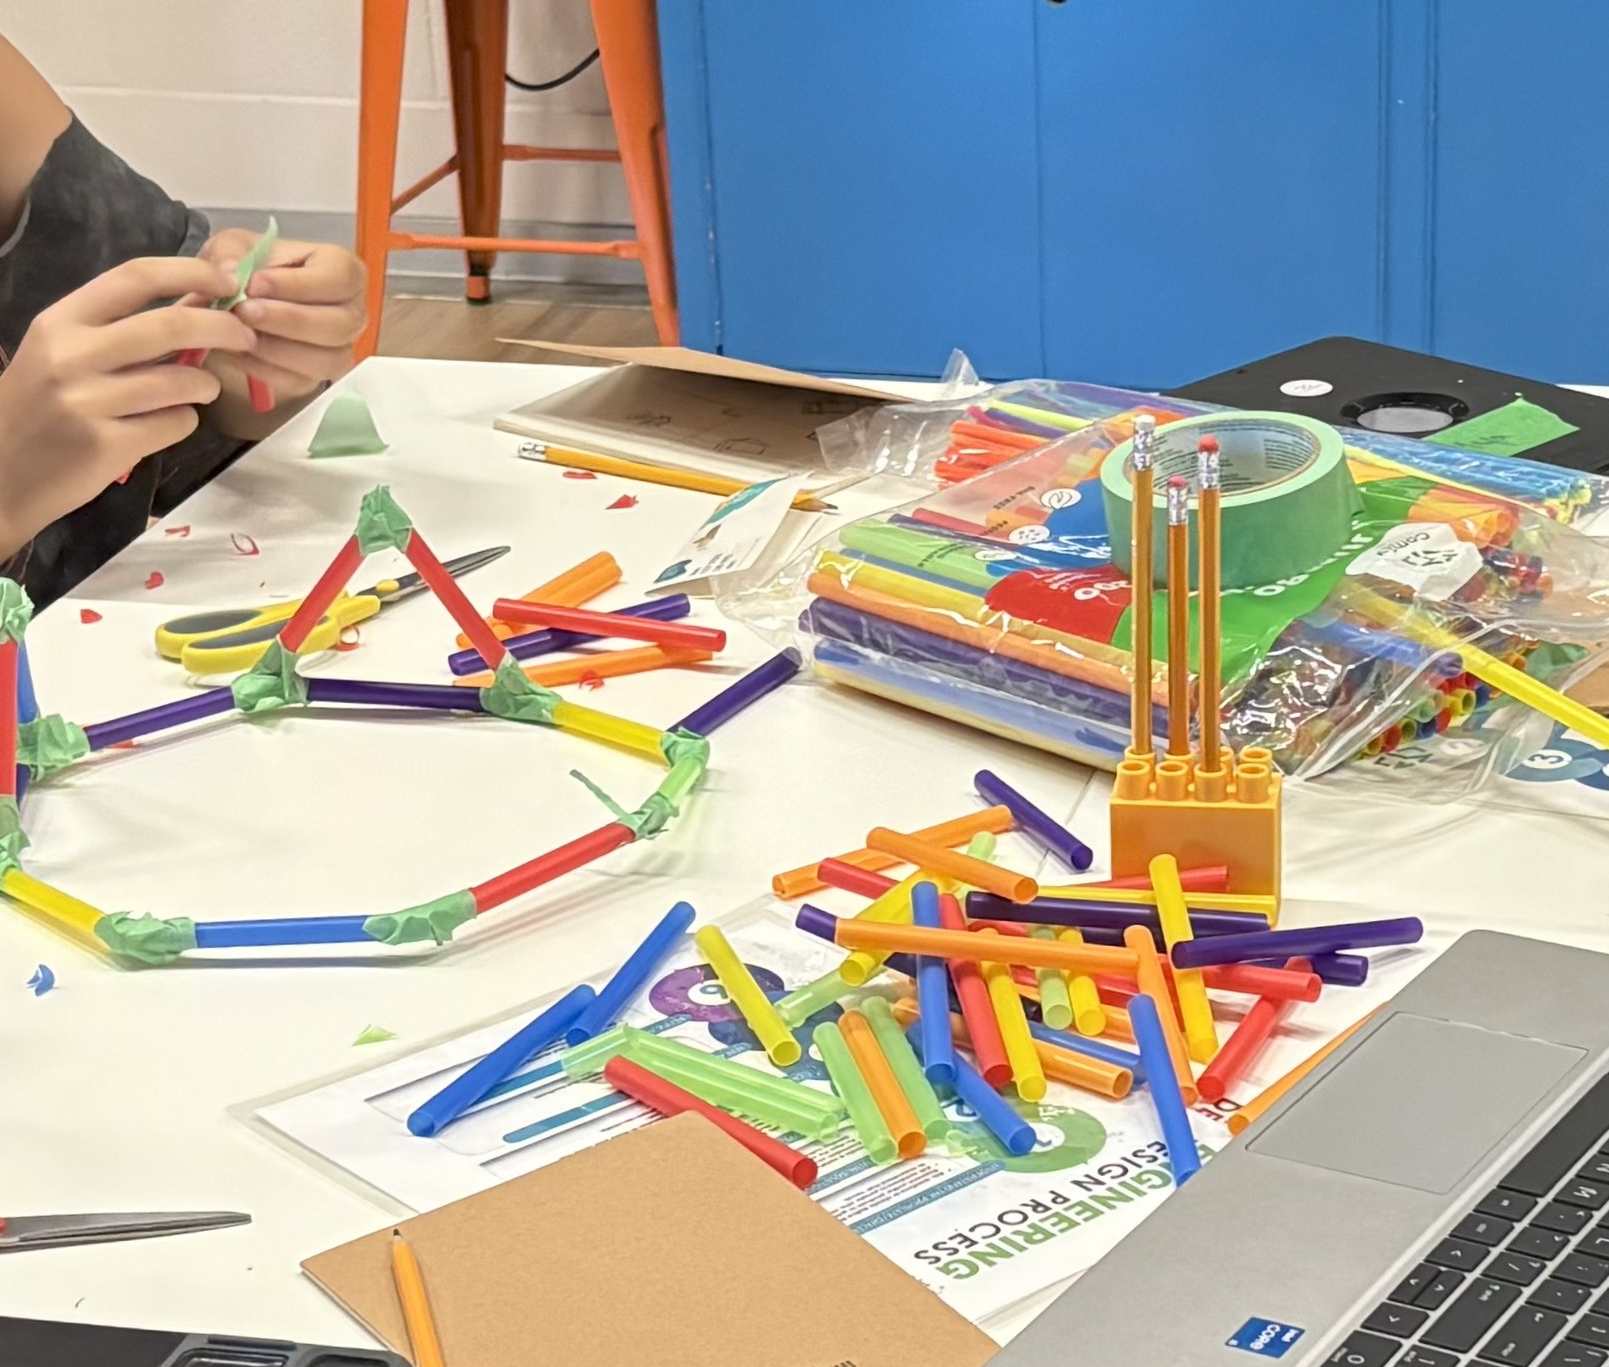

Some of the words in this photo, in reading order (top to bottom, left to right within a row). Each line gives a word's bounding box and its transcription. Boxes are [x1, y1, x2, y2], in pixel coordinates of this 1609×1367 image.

[1573, 1185, 1598, 1199] M
[914, 1189, 1072, 1265] PROCESS
[1346, 1354, 1366, 1365] 0
